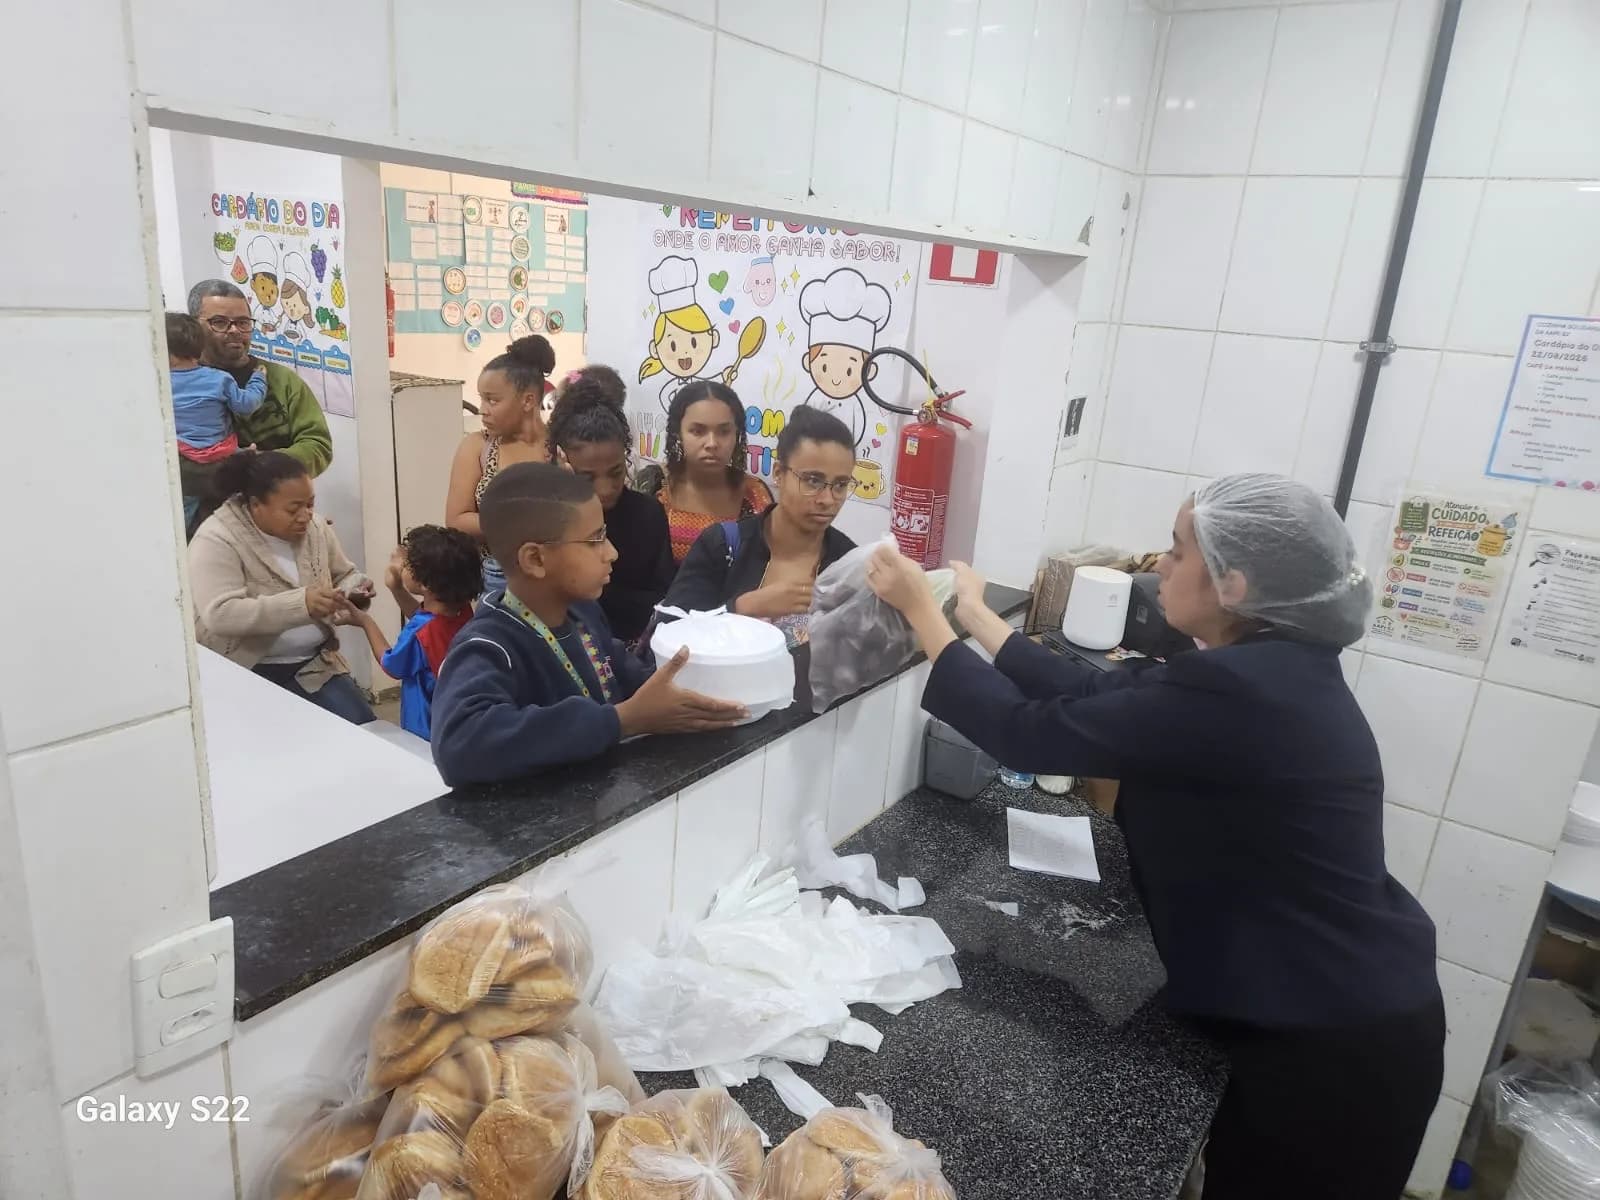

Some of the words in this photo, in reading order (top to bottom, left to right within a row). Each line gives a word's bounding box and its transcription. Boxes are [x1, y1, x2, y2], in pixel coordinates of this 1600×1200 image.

[211, 192, 279, 223] CARDÁPIO
[283, 199, 307, 227] DO
[311, 202, 340, 229] DIA
[679, 207, 860, 236] REFEI
[654, 229, 694, 250] ONDE
[699, 231, 712, 251] O
[716, 232, 761, 254] AMOR
[766, 235, 826, 257] GANHA
[830, 238, 900, 262] SABOR!
[1535, 339, 1576, 350] Cardápio
[1577, 343, 1590, 351] do
[745, 405, 786, 438] OM
[1427, 525, 1480, 542] REFEIÇÃO
